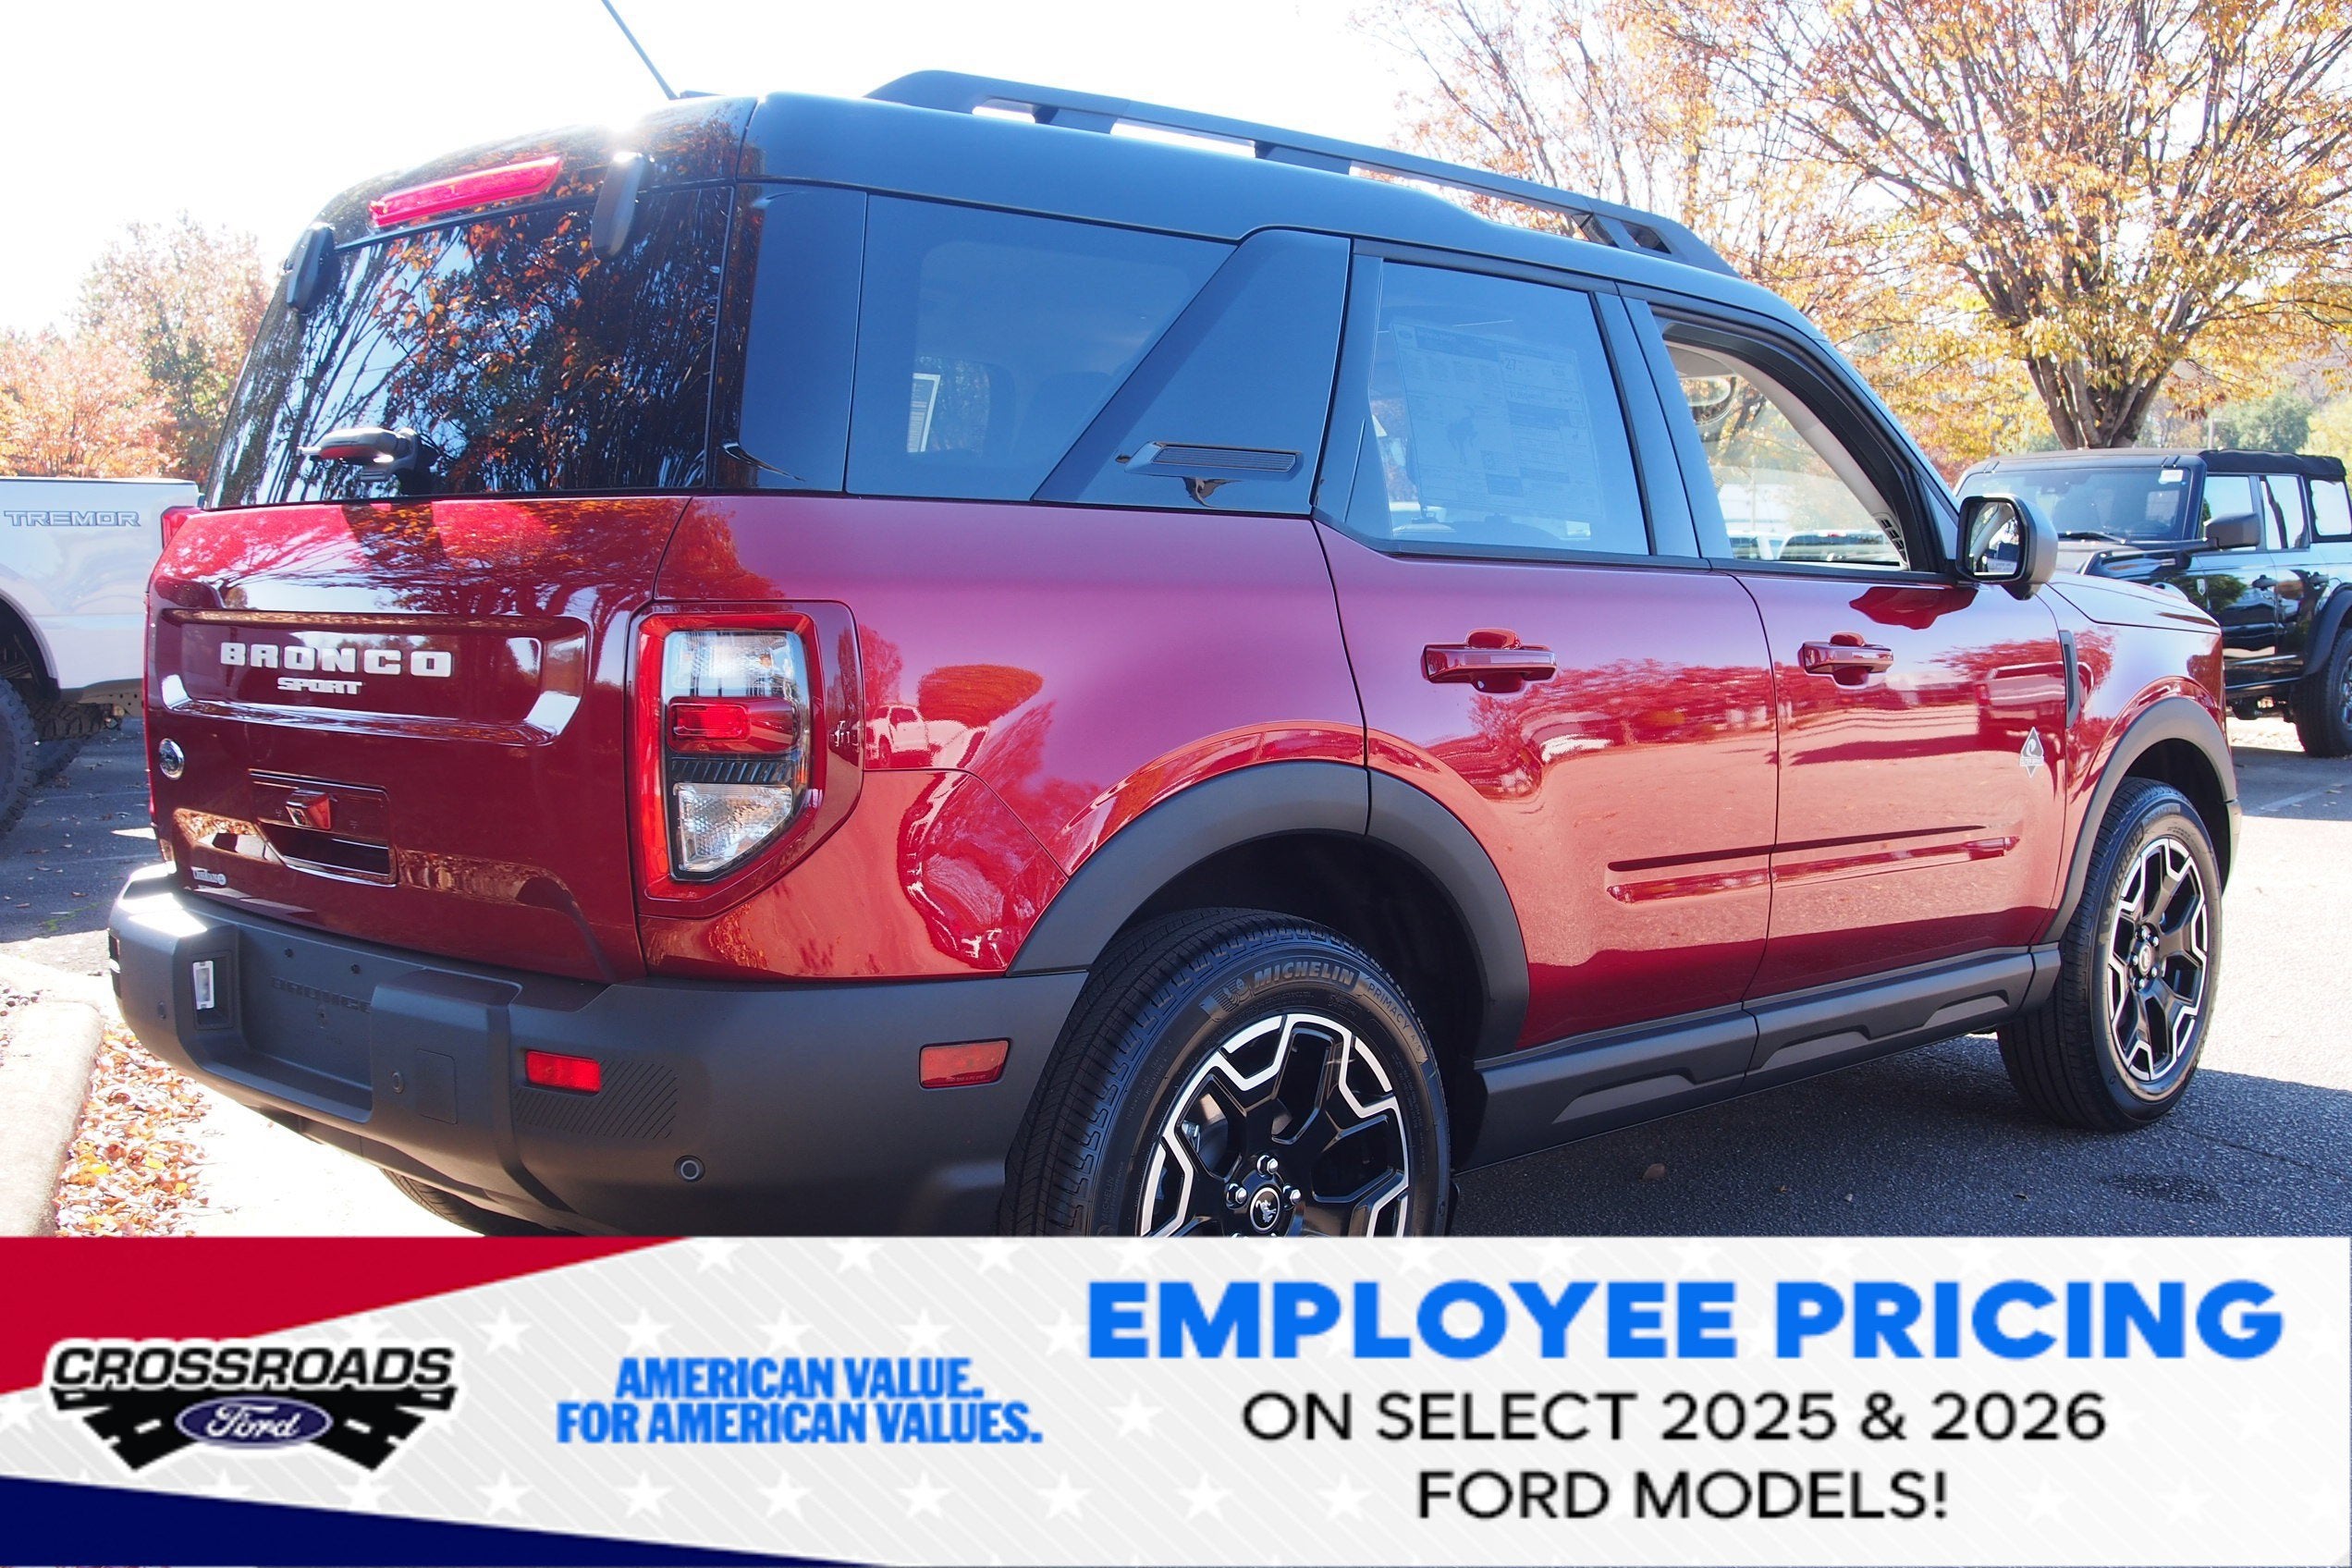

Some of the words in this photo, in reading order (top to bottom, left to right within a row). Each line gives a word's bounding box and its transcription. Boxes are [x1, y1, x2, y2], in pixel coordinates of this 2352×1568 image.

[4, 510, 141, 527] TREMOR
[220, 642, 452, 678] BRONCO
[277, 677, 362, 694] SPORT
[1254, 961, 1355, 988] MICHELIN
[1367, 983, 1411, 1029] PRIMACY
[1410, 1034, 1422, 1053] A/S
